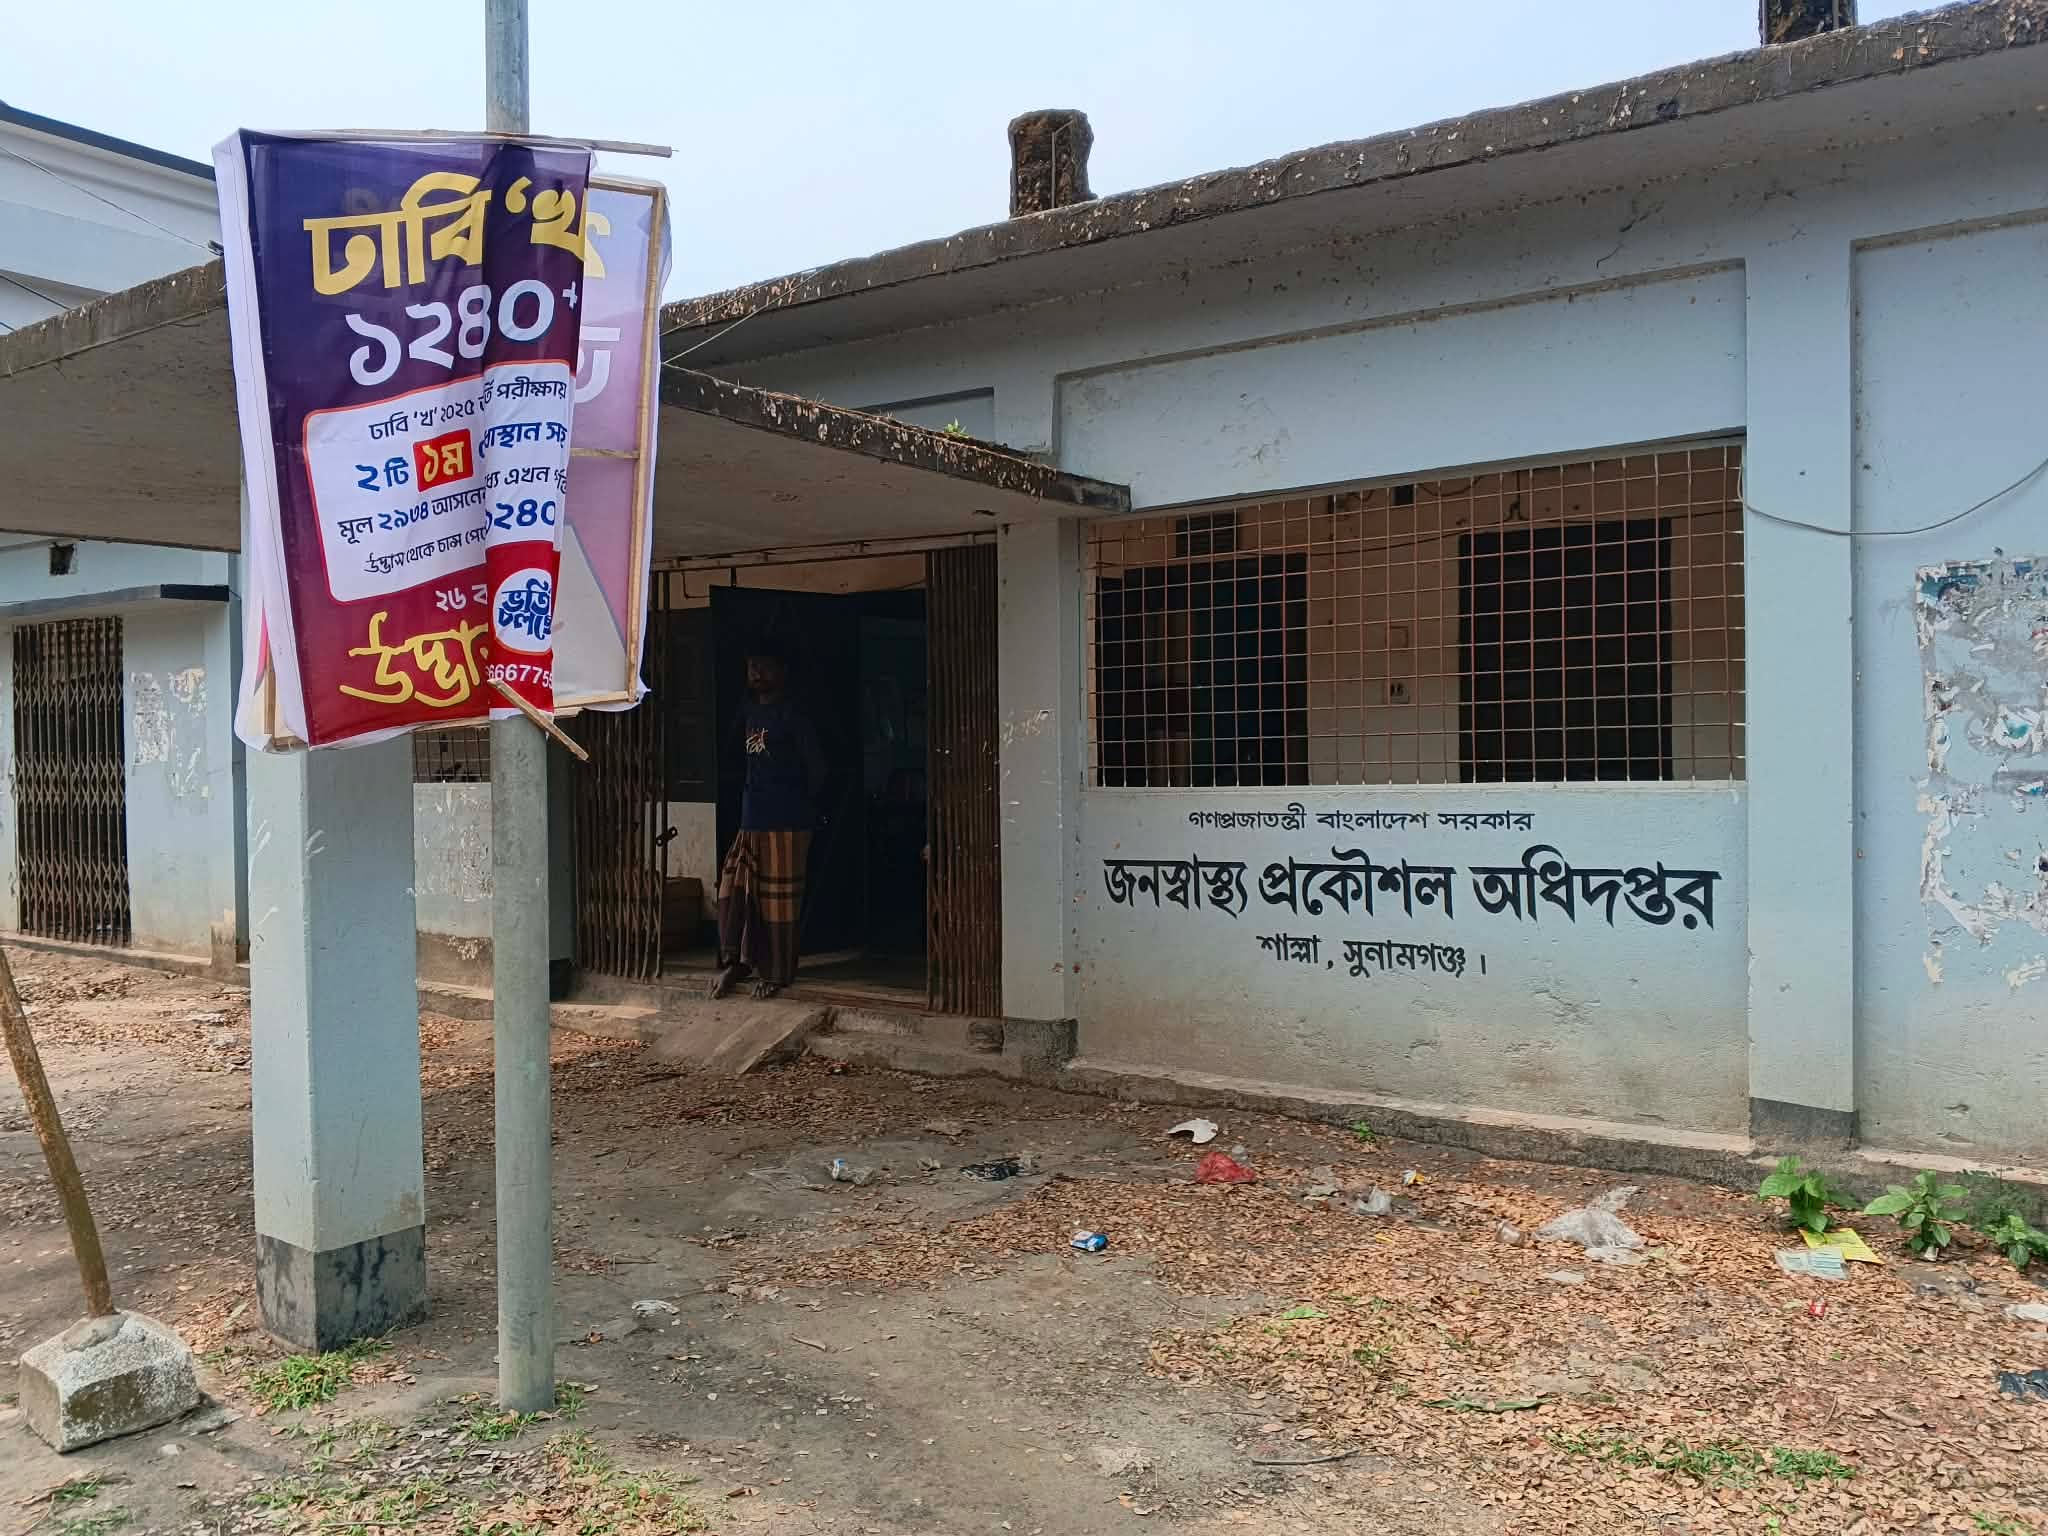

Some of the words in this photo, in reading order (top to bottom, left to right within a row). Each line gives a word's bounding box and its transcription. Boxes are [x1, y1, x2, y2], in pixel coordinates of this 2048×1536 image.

[303, 172, 492, 295] ঢাবি
[368, 411, 409, 440] ঢাবি
[422, 441, 464, 482] ১ম
[338, 516, 374, 544] মূল
[378, 501, 429, 530] ২৯৩৪
[504, 467, 551, 485] এখন
[406, 541, 435, 563] থেকে
[339, 611, 489, 708] উদ্ভা
[1315, 808, 1429, 831] বাংলাদেশ
[1437, 811, 1535, 832] সরকার
[1103, 852, 1249, 919] জনস্বাস্থ্য
[1258, 846, 1457, 920] প্রকৌশল
[1468, 844, 1722, 930] অধিদপ্তর
